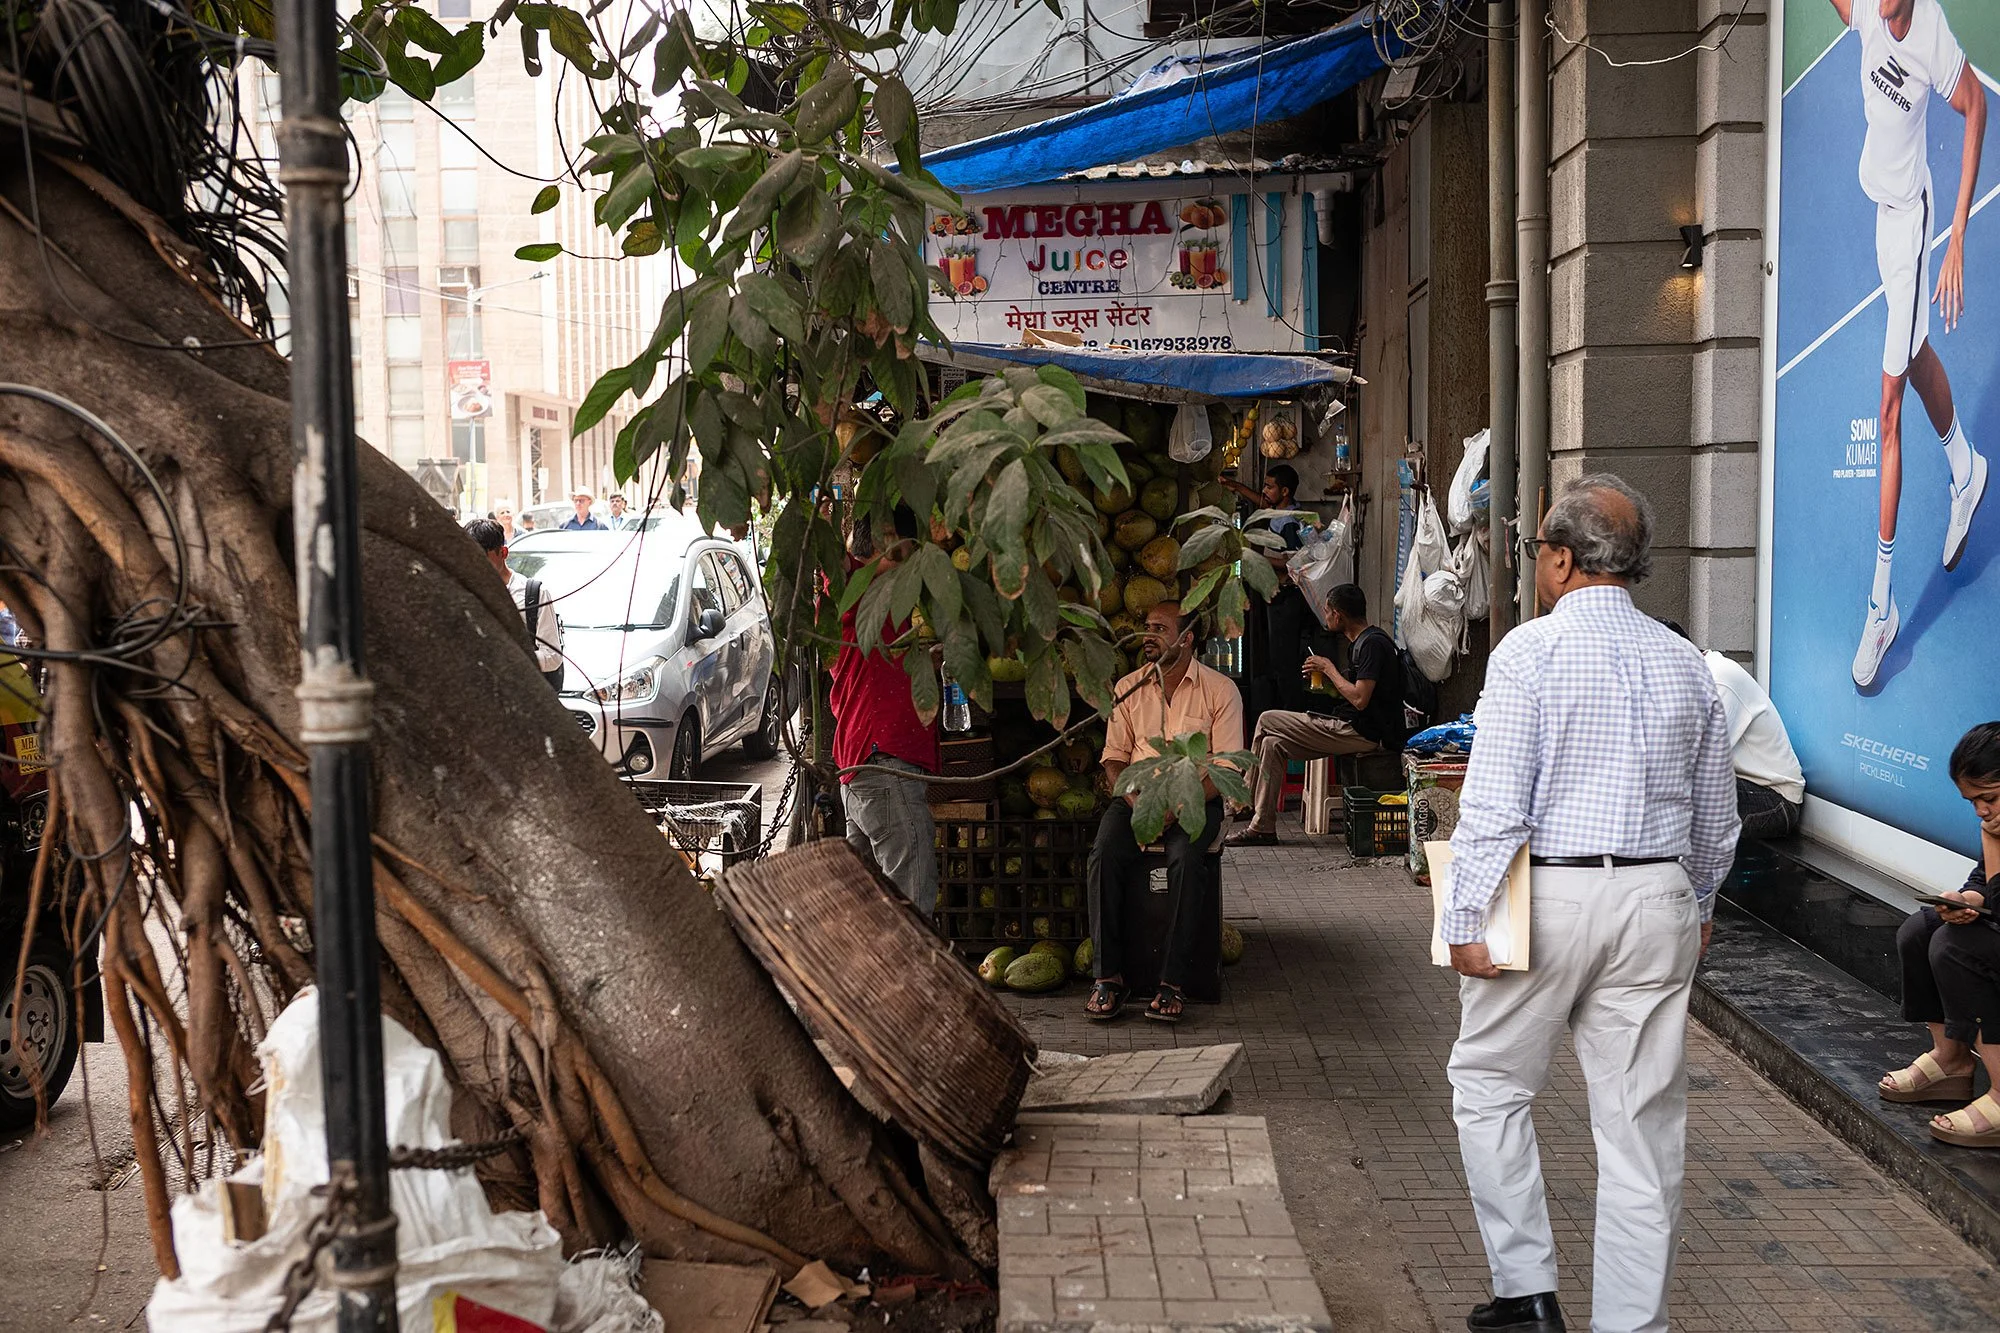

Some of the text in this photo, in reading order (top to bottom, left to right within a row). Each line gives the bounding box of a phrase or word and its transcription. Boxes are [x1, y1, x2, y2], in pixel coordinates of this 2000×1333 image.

[1870, 70, 1912, 112] SKECHERS
[982, 201, 1171, 240] MEGHA
[1027, 245, 1128, 272] Juice
[1038, 279, 1119, 295] CENTRE
[1005, 300, 1152, 333] मेघा ज्यूस सेंटर
[1850, 417, 1877, 442] SONU
[1845, 442, 1877, 466] KUMAR
[1840, 732, 1929, 771] SKECHERS
[1859, 762, 1906, 788] PICKLEBALL
